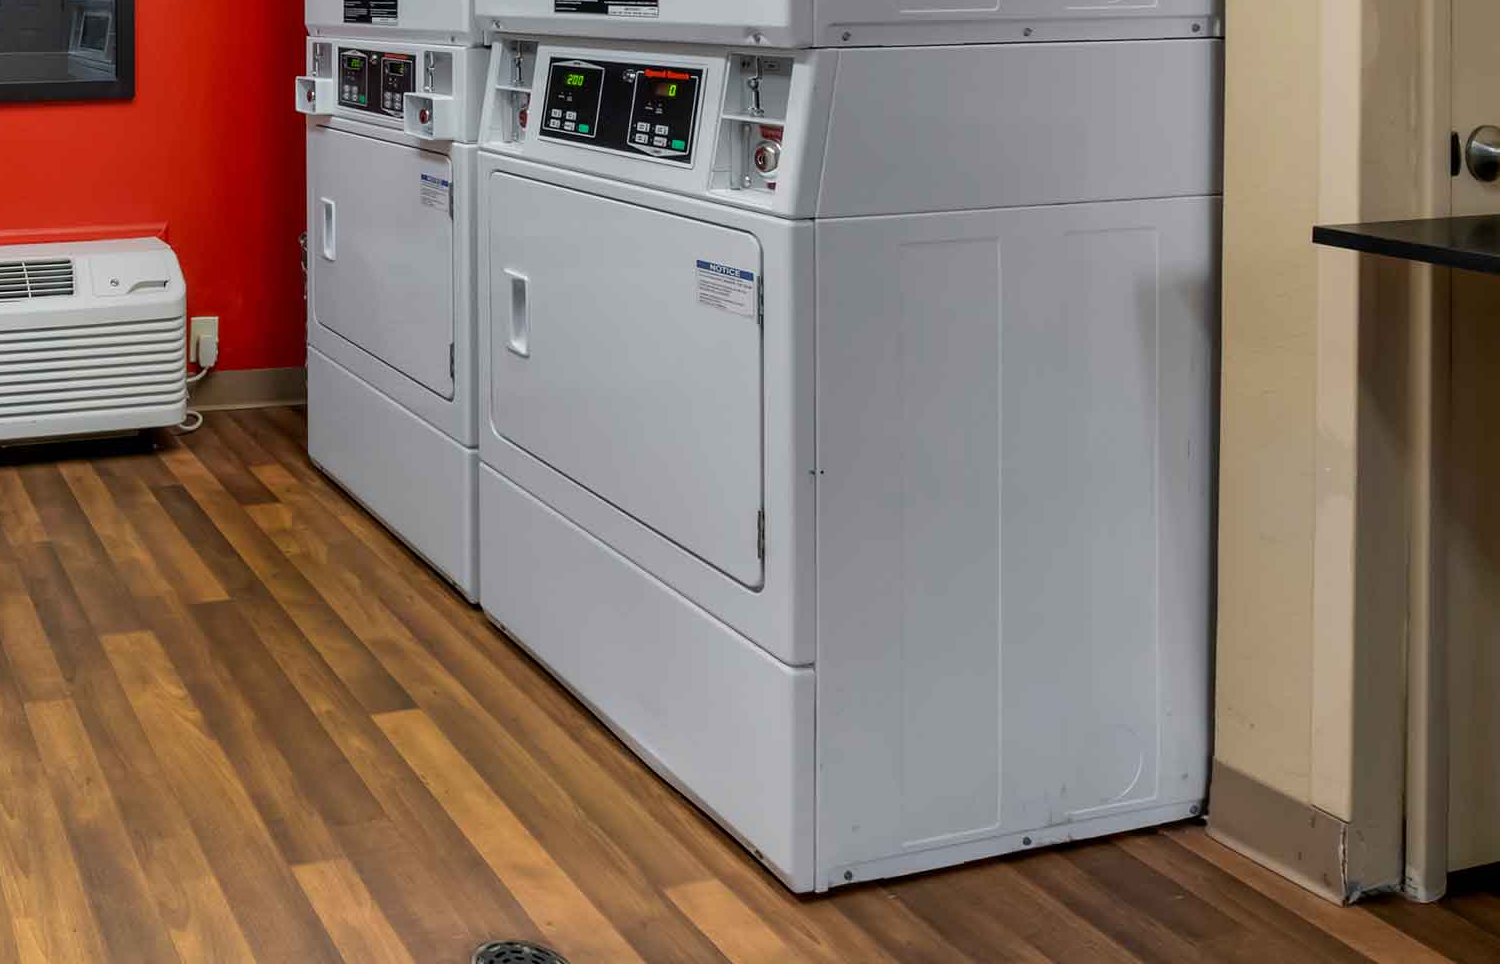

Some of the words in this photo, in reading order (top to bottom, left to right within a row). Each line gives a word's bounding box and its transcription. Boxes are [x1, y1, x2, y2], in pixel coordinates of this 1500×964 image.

[566, 74, 584, 86] 200
[668, 84, 677, 97] 0
[709, 263, 740, 277] NOTICE
